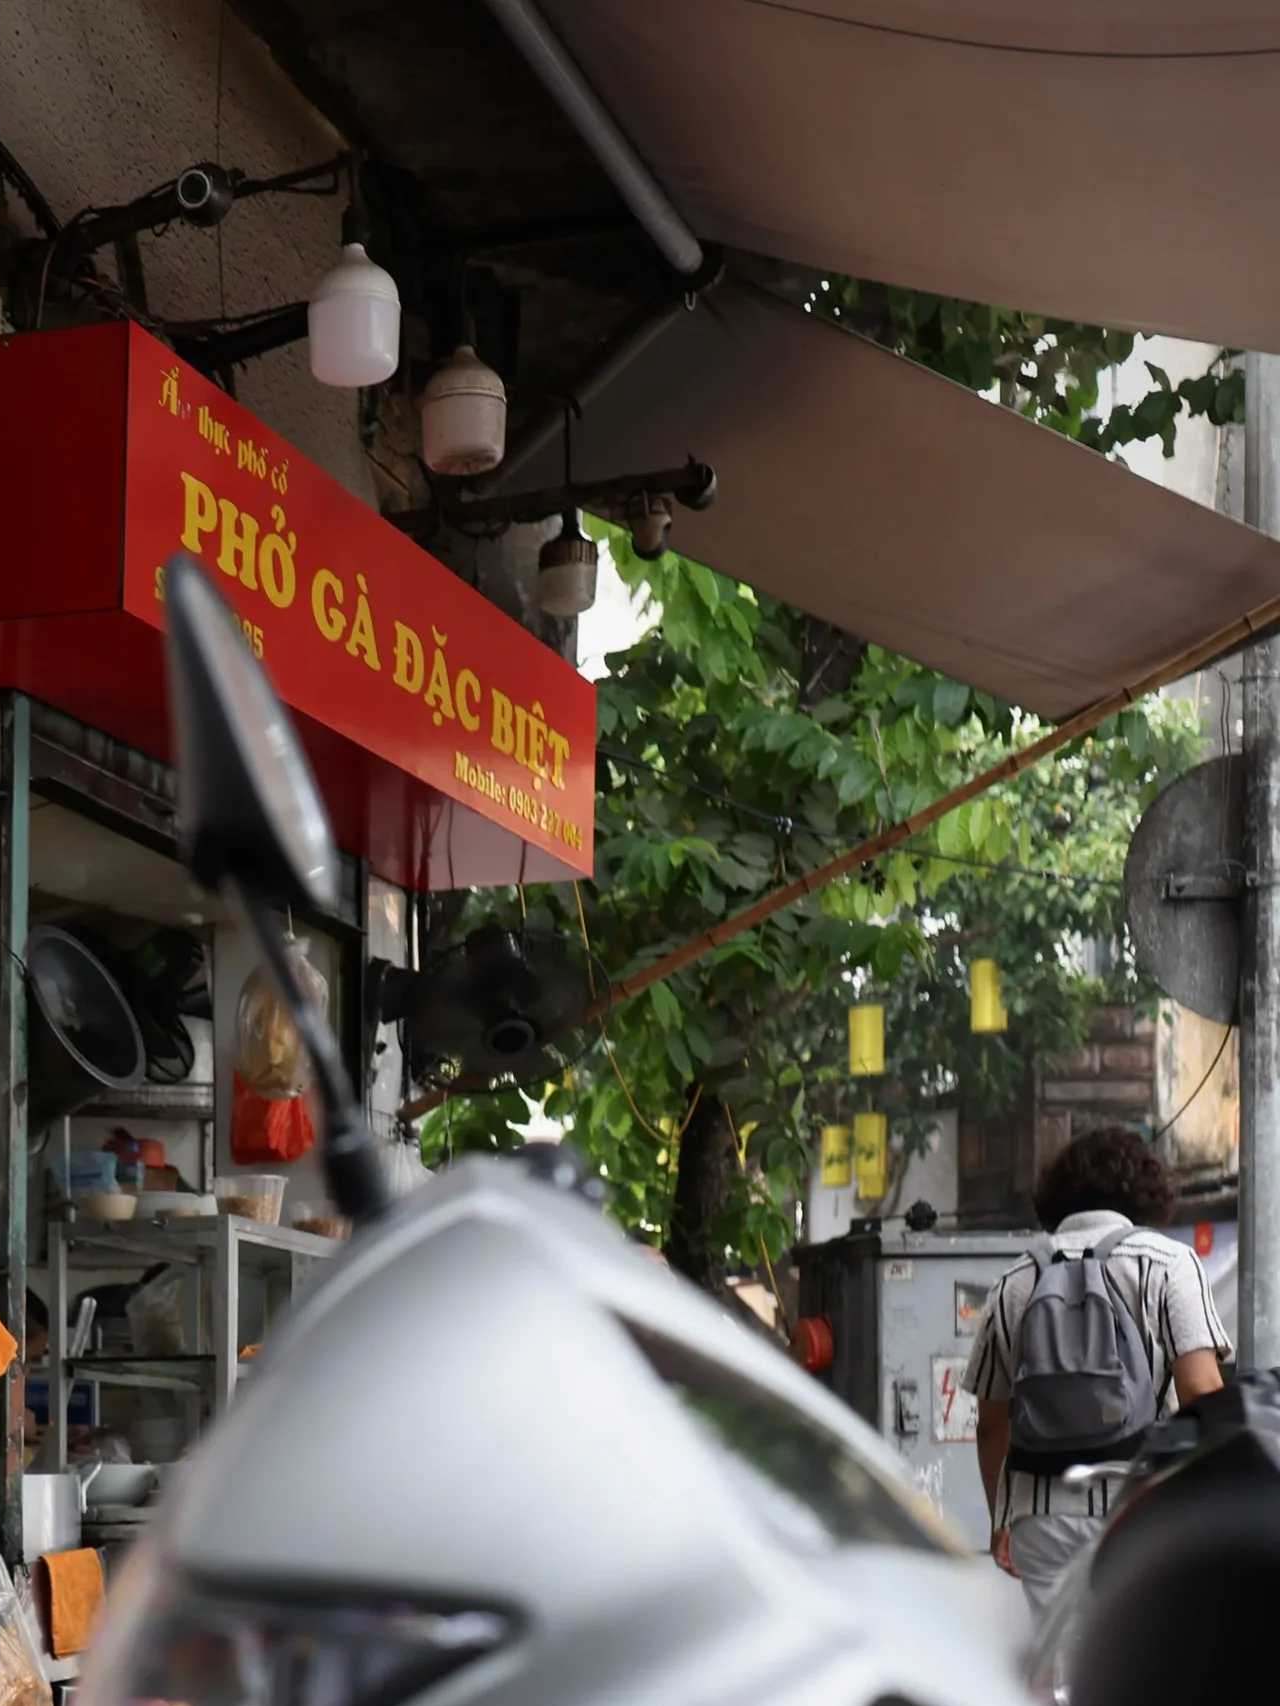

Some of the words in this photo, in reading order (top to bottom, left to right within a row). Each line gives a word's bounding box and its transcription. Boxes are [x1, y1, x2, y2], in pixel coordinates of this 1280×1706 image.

[180, 472, 297, 609] PHỞ
[311, 568, 381, 671] GÀ
[393, 623, 481, 732] ĐẶC
[490, 688, 570, 791] BIỆT
[455, 751, 506, 804] Mobile:
[509, 785, 538, 826] 0903
